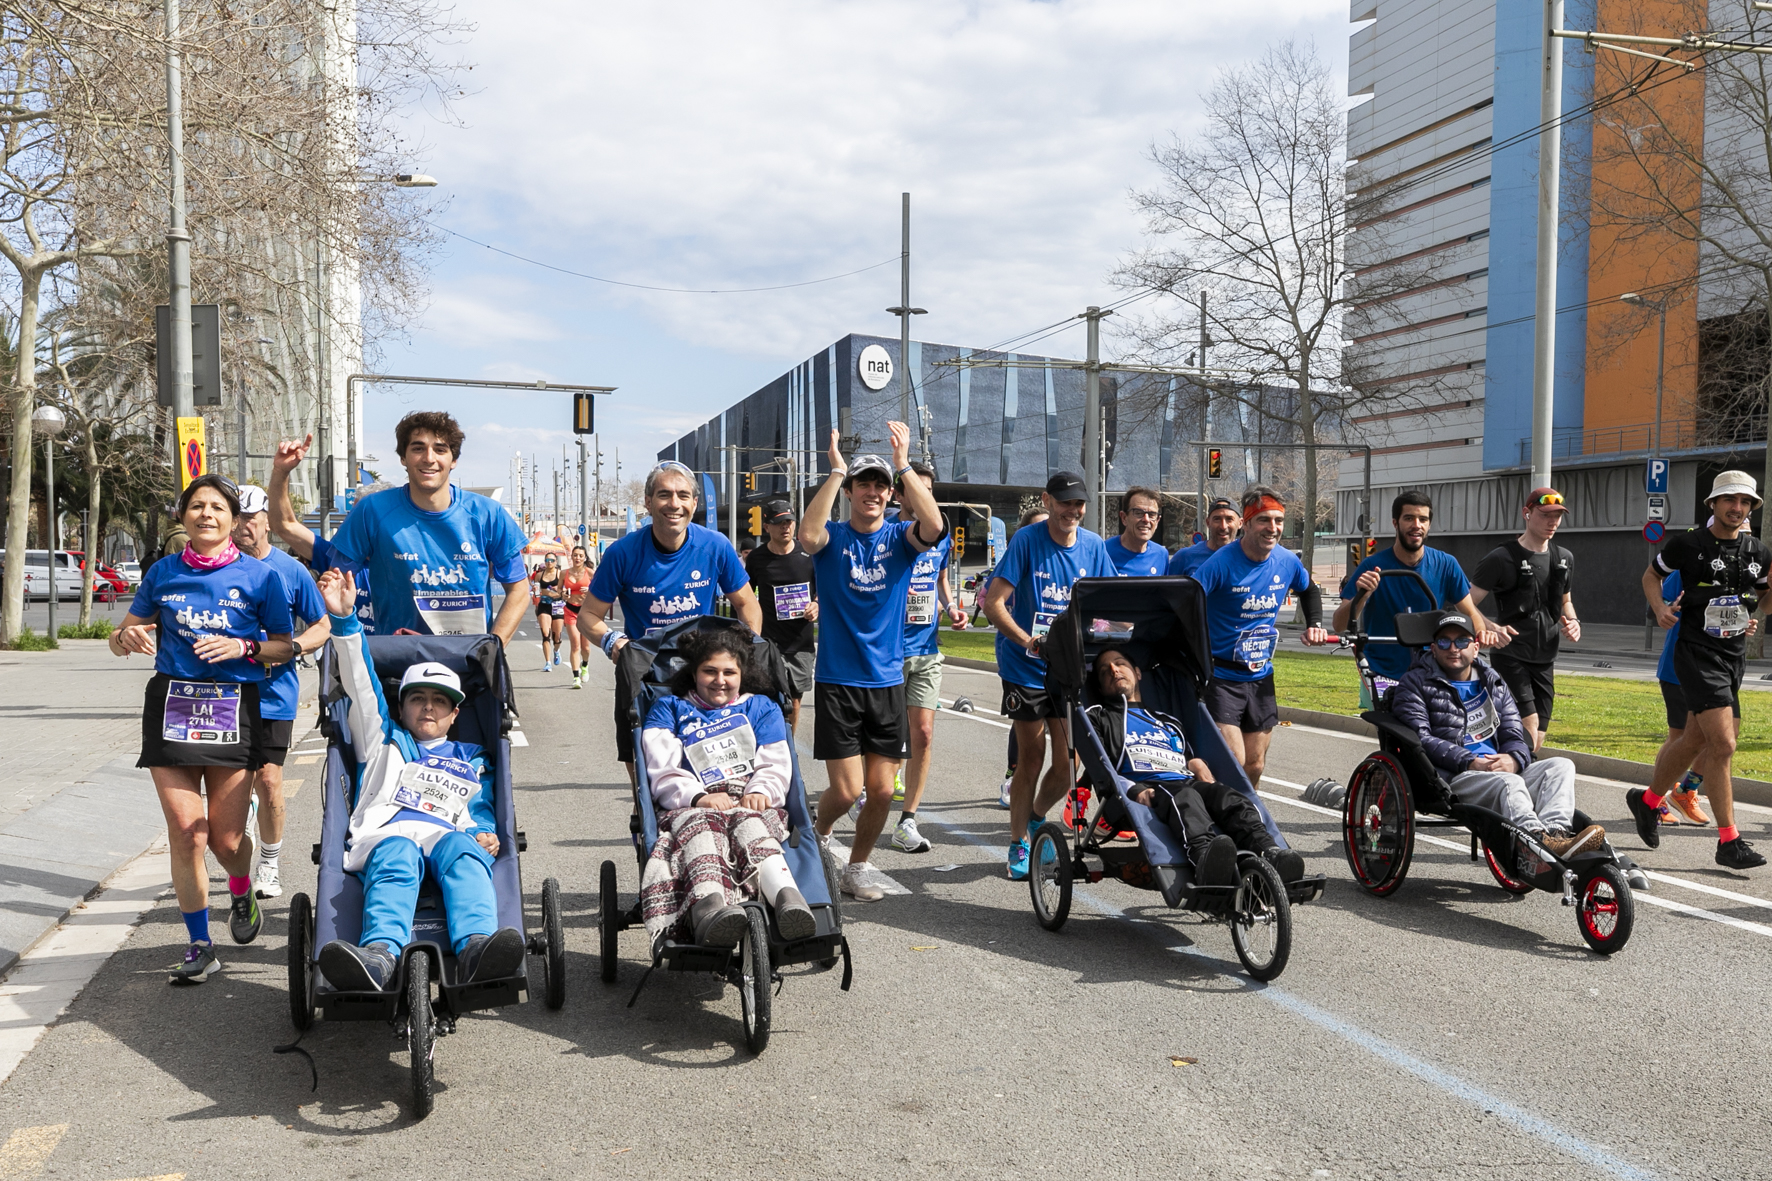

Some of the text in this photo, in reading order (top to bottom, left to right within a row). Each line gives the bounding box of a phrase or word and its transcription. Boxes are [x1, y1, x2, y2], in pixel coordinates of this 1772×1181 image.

[868, 360, 890, 373] nat
[1651, 461, 1665, 479] P
[684, 580, 710, 589] ZURICH
[356, 588, 369, 597] fat
[218, 599, 246, 609] ZURICH
[906, 596, 930, 605] LBERT
[1720, 610, 1738, 619] LUIS
[192, 703, 213, 716] LAI
[1464, 700, 1481, 710] URICH
[1468, 711, 1483, 722] ON
[707, 721, 732, 733] ZURICH
[440, 761, 468, 774] ZURICH
